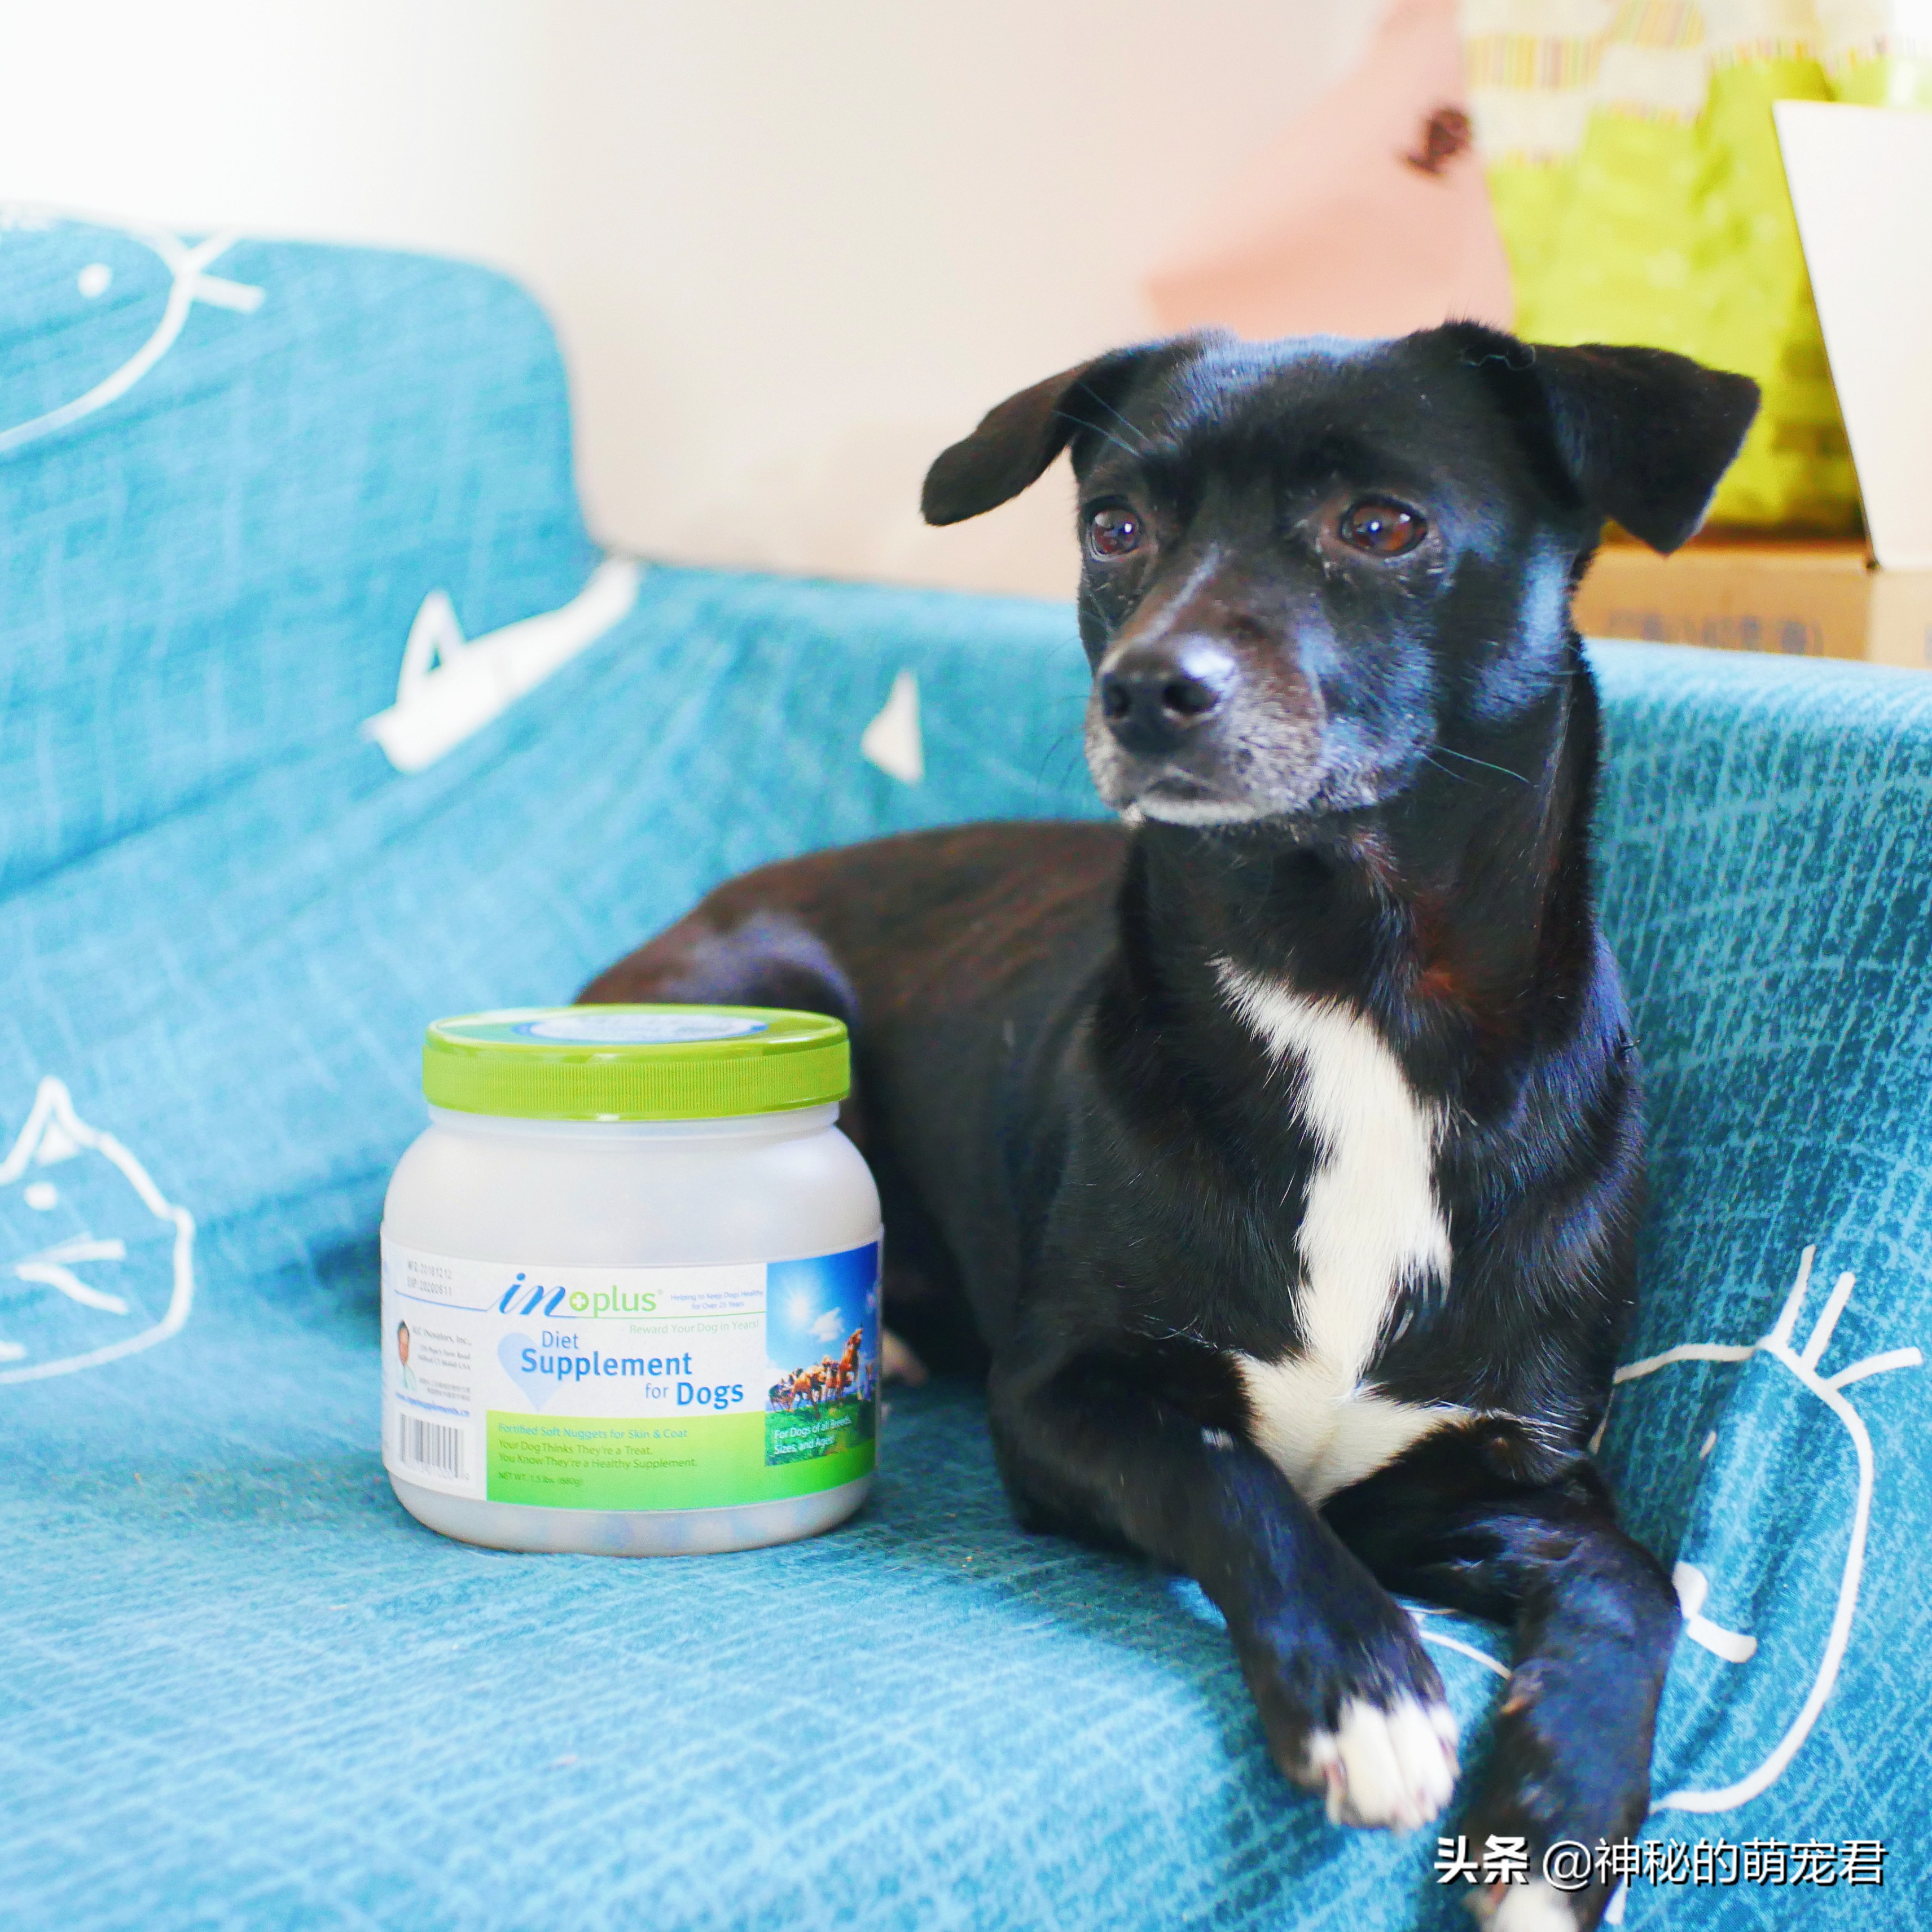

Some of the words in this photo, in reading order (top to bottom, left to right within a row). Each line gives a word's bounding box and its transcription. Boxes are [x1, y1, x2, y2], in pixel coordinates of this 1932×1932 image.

[671, 1293, 696, 1301] Helping
[741, 1289, 763, 1298] Healthy
[630, 1324, 668, 1334] Reward
[671, 1324, 695, 1333] Your
[697, 1322, 718, 1334] Dog
[721, 1322, 729, 1331] in
[732, 1319, 759, 1330] Years!
[542, 1331, 578, 1350] Diet
[520, 1348, 693, 1382] Supplement
[645, 1382, 669, 1399] for
[677, 1381, 744, 1410] Dogs
[498, 1422, 538, 1435] Fortified
[541, 1426, 560, 1437] Soft
[564, 1429, 607, 1439] Nuggets
[610, 1429, 625, 1438] for
[628, 1429, 649, 1439] Skin
[653, 1429, 661, 1438] &
[663, 1428, 688, 1438] Coat
[775, 1429, 788, 1440] For
[790, 1427, 811, 1438] Dogs
[812, 1422, 820, 1433] of
[498, 1439, 518, 1449] Your
[520, 1441, 541, 1454] Dog
[542, 1443, 573, 1454] Thinks
[577, 1444, 613, 1457] They're
[625, 1445, 653, 1455] Treat.
[798, 1438, 814, 1451] and
[498, 1452, 515, 1463] You
[517, 1454, 543, 1465] Know
[546, 1456, 581, 1468] They're
[592, 1458, 631, 1470] Healthy
